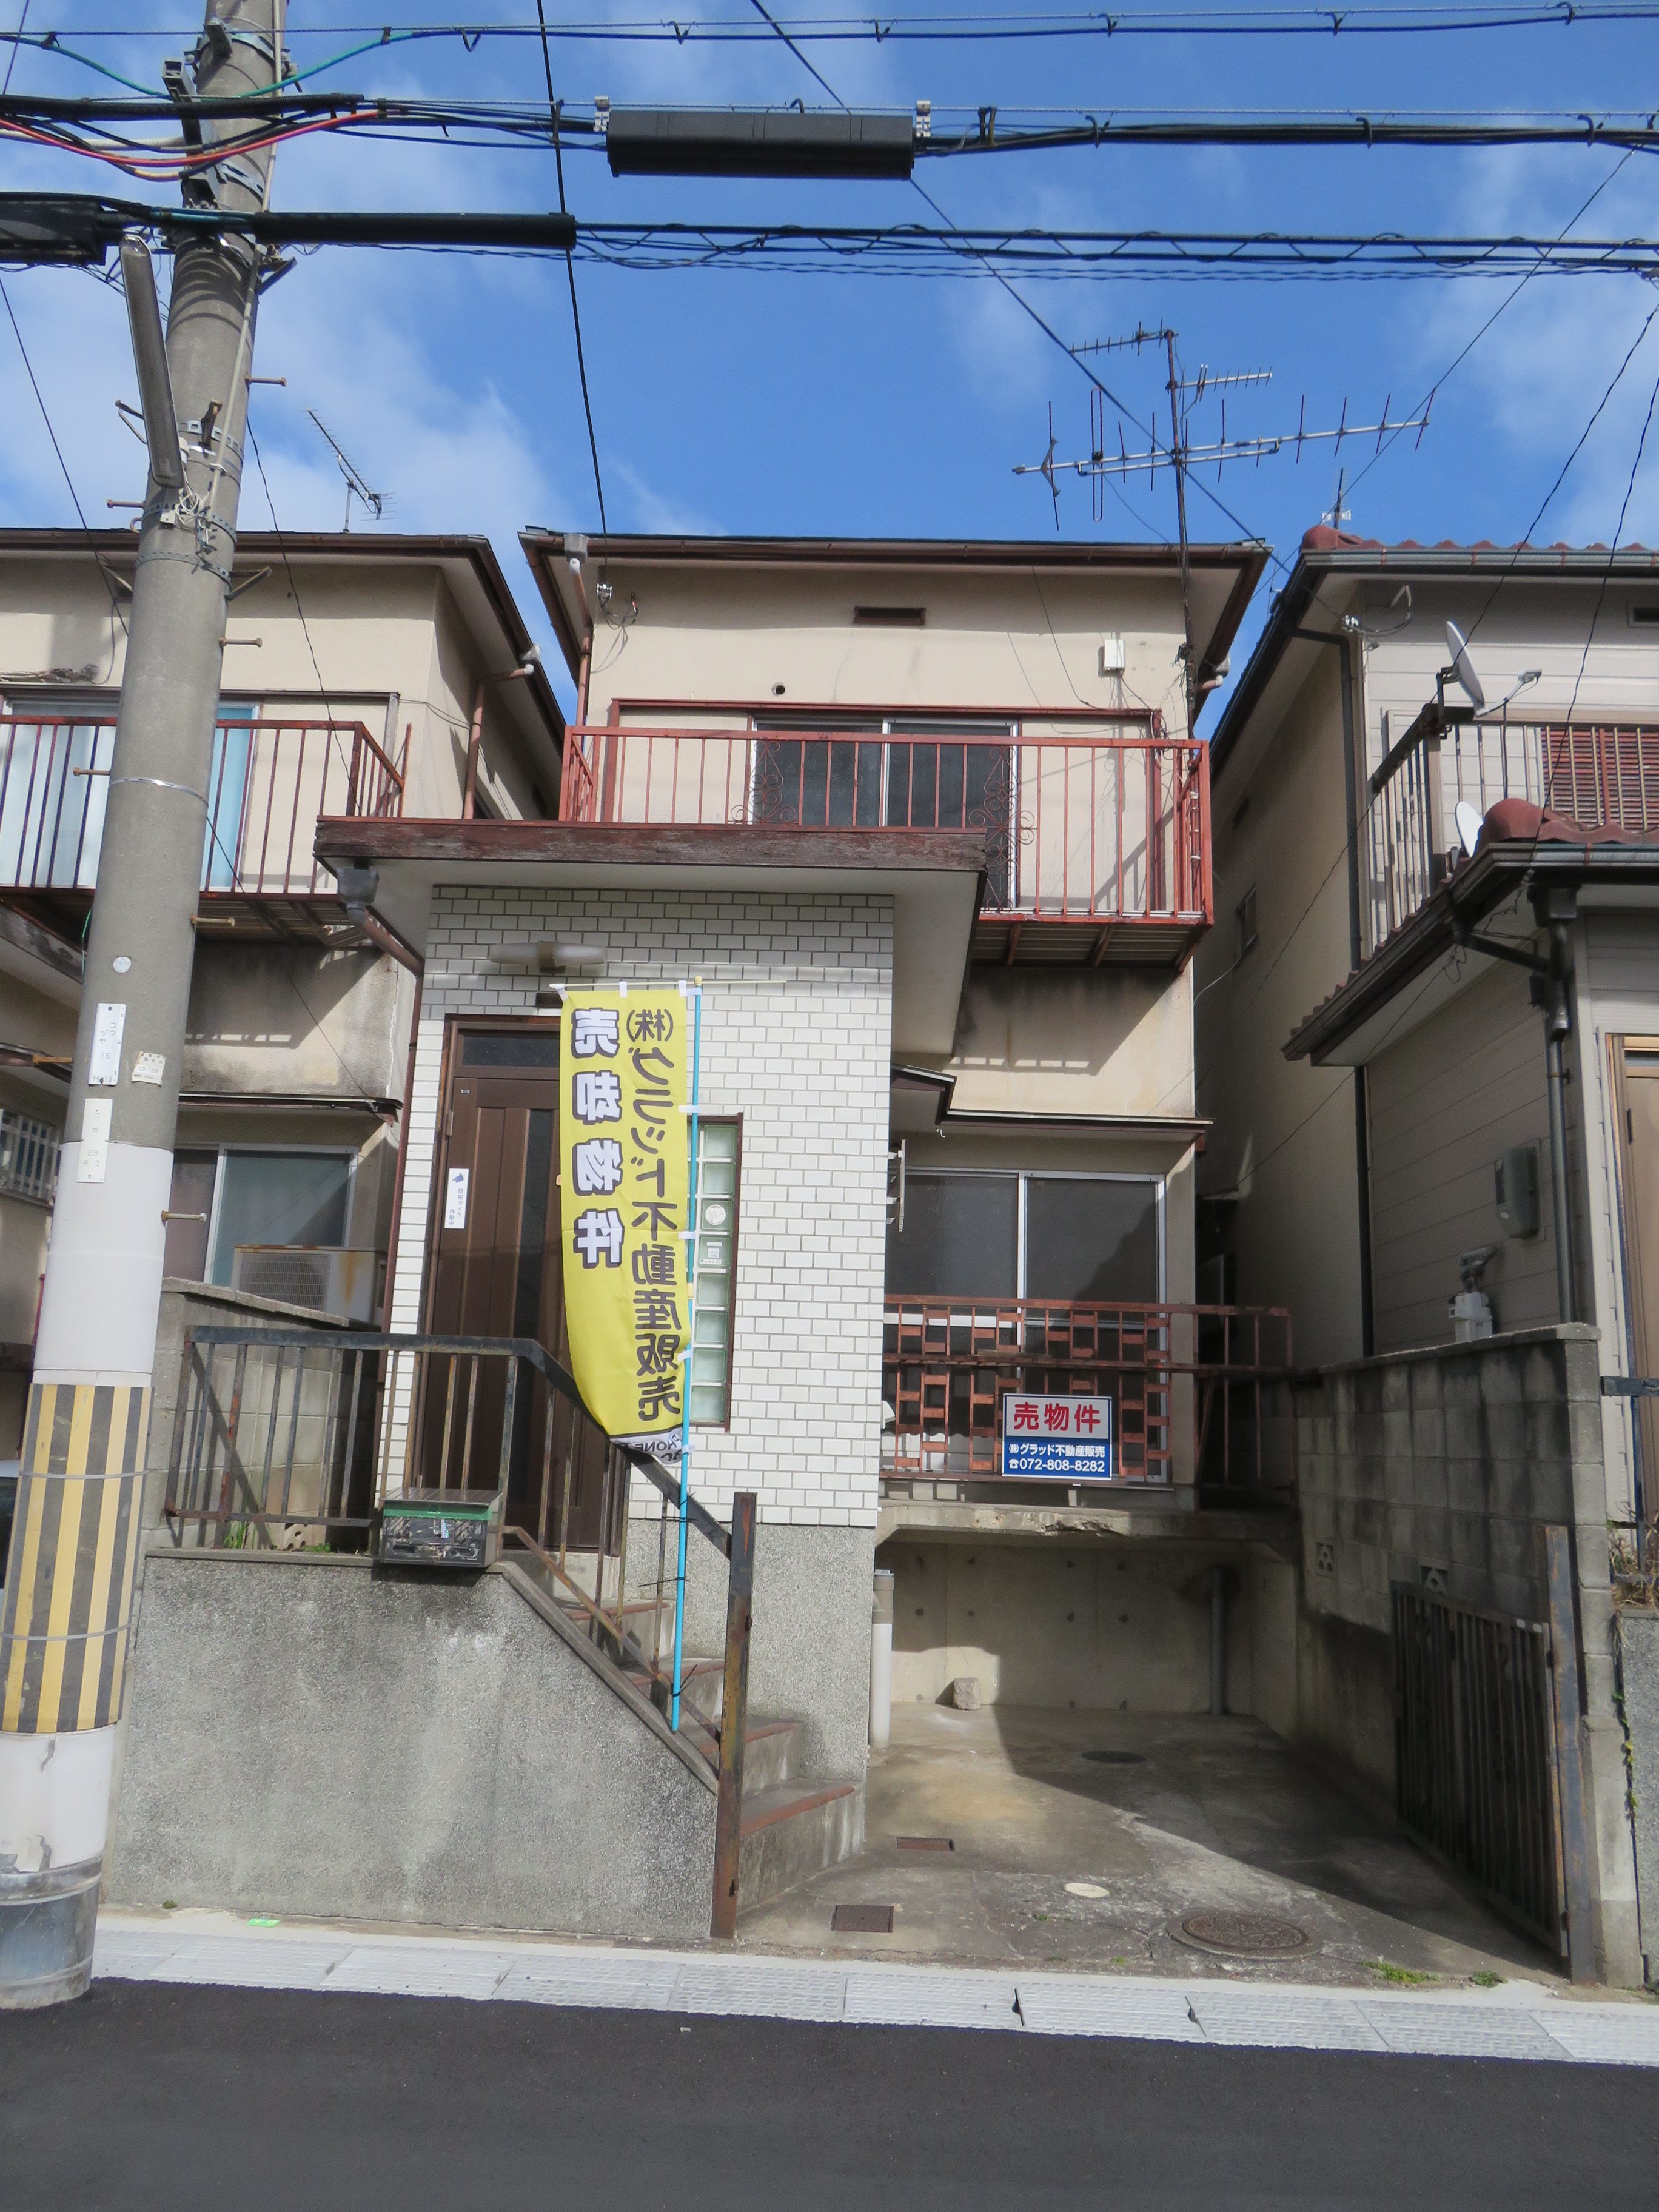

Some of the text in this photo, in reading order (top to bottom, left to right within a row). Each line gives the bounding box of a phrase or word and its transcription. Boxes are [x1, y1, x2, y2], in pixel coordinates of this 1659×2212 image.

[1013, 1401, 1101, 1434] 売物件
[1019, 1458, 1105, 1472] 072-808-8282
